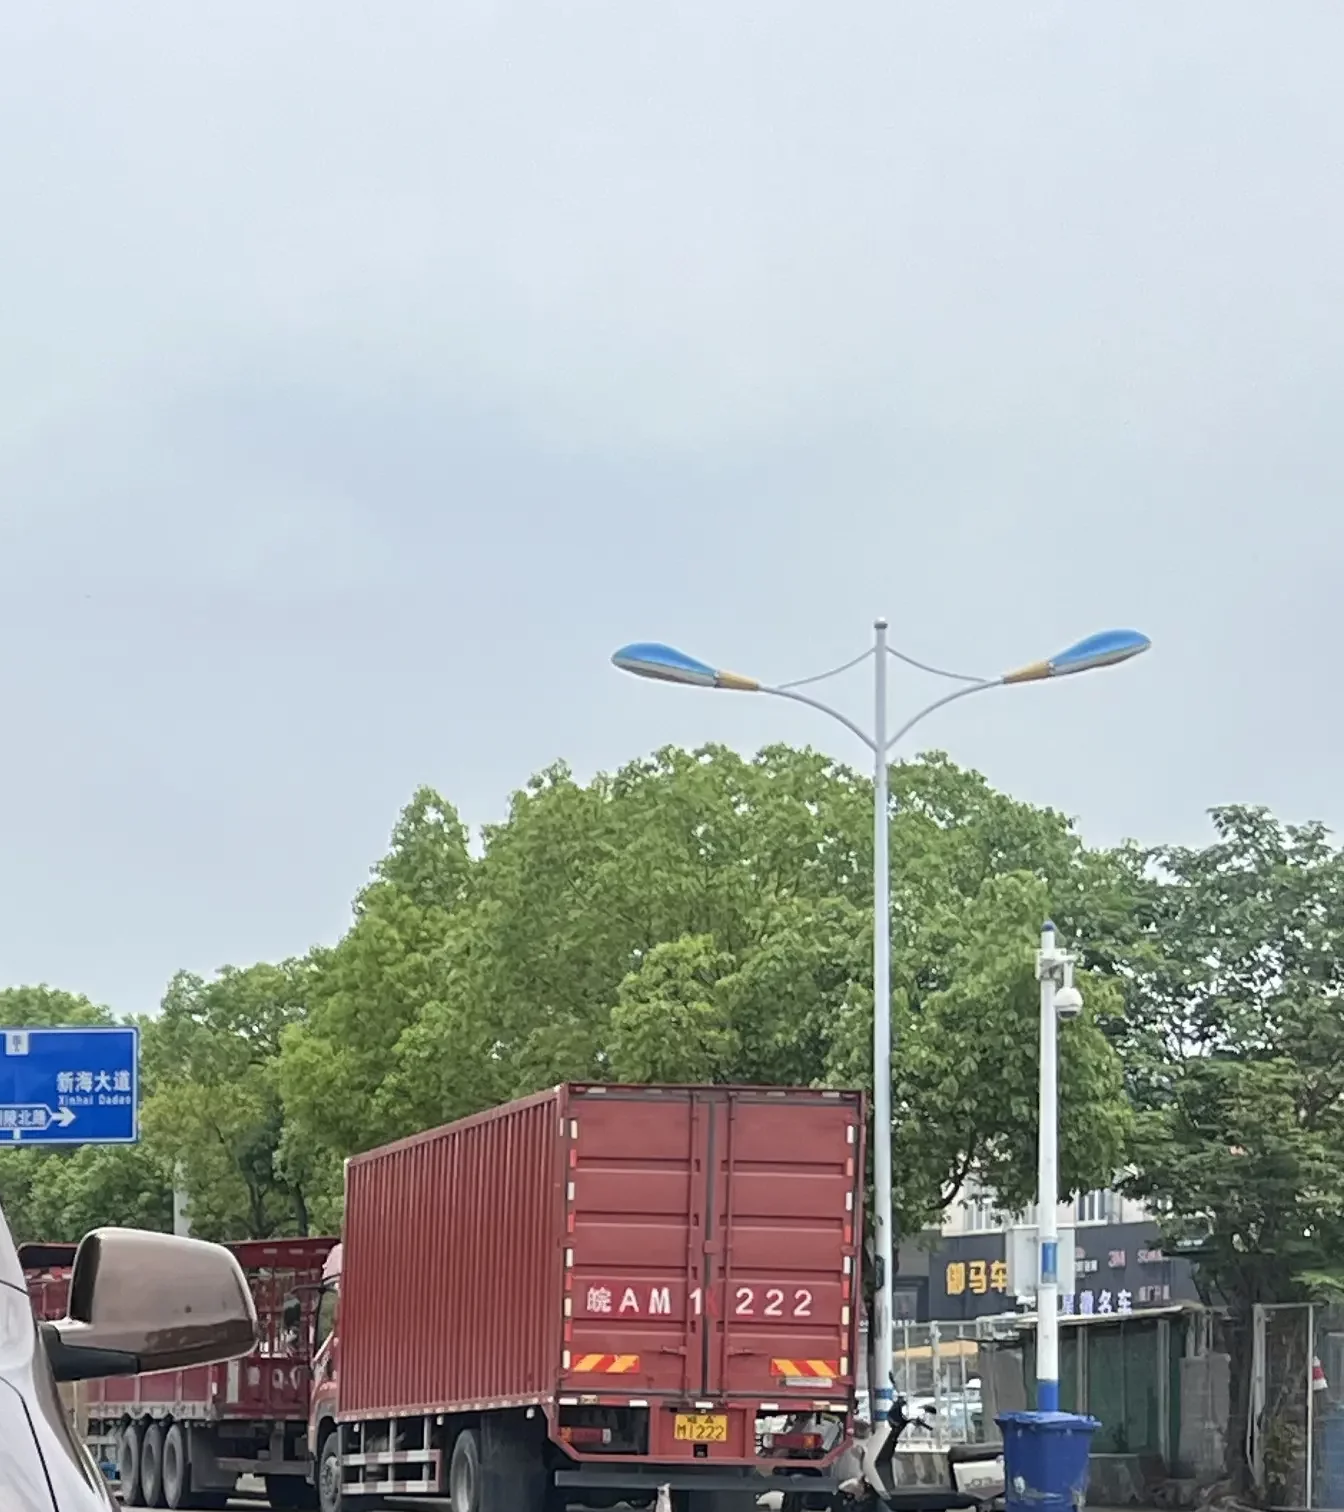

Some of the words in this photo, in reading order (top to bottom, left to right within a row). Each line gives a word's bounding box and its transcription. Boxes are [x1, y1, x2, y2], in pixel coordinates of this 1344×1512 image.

[56, 1070, 131, 1093] 新海大道
[677, 1424, 725, 1440] M1222
